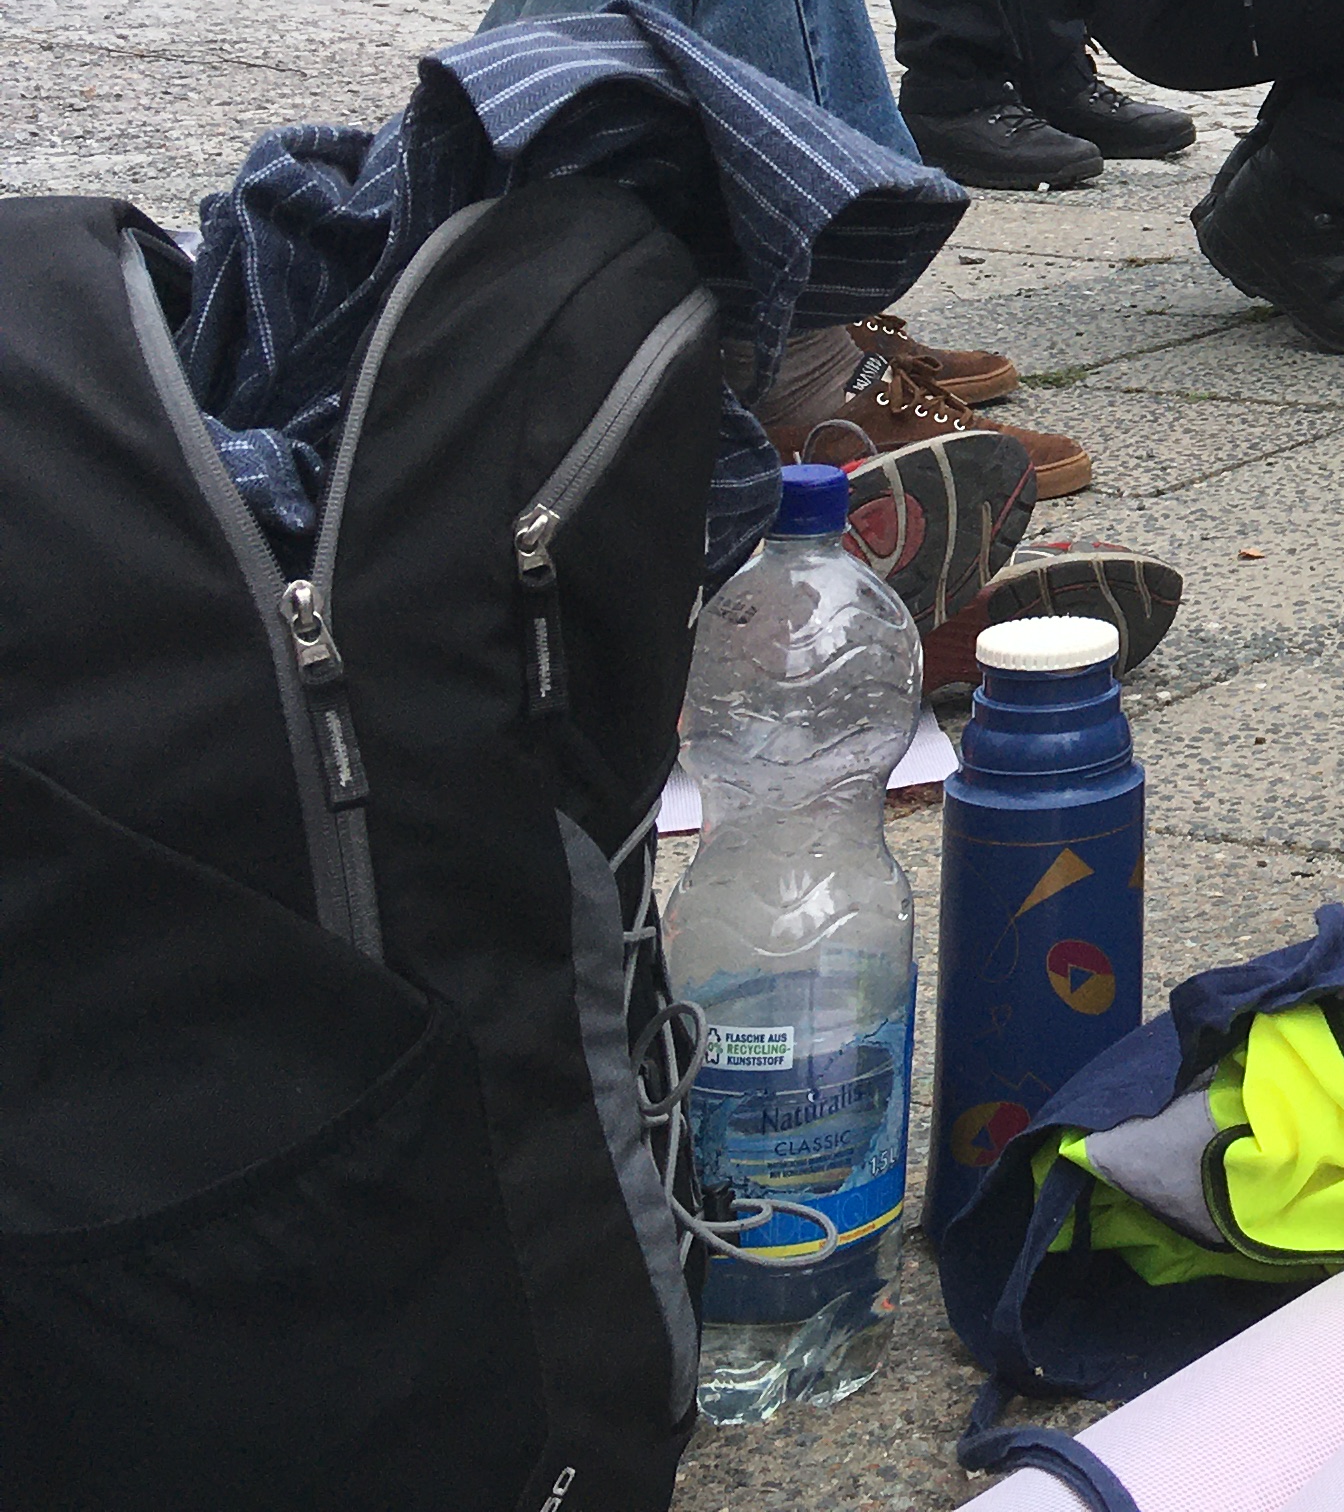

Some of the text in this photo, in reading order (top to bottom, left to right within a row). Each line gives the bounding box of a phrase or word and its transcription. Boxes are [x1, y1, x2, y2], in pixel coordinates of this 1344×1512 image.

[725, 1033, 787, 1043] FLASCHE AUS
[726, 1043, 791, 1055] RECYCLING-
[727, 1055, 785, 1066] KUNSTSTOFF
